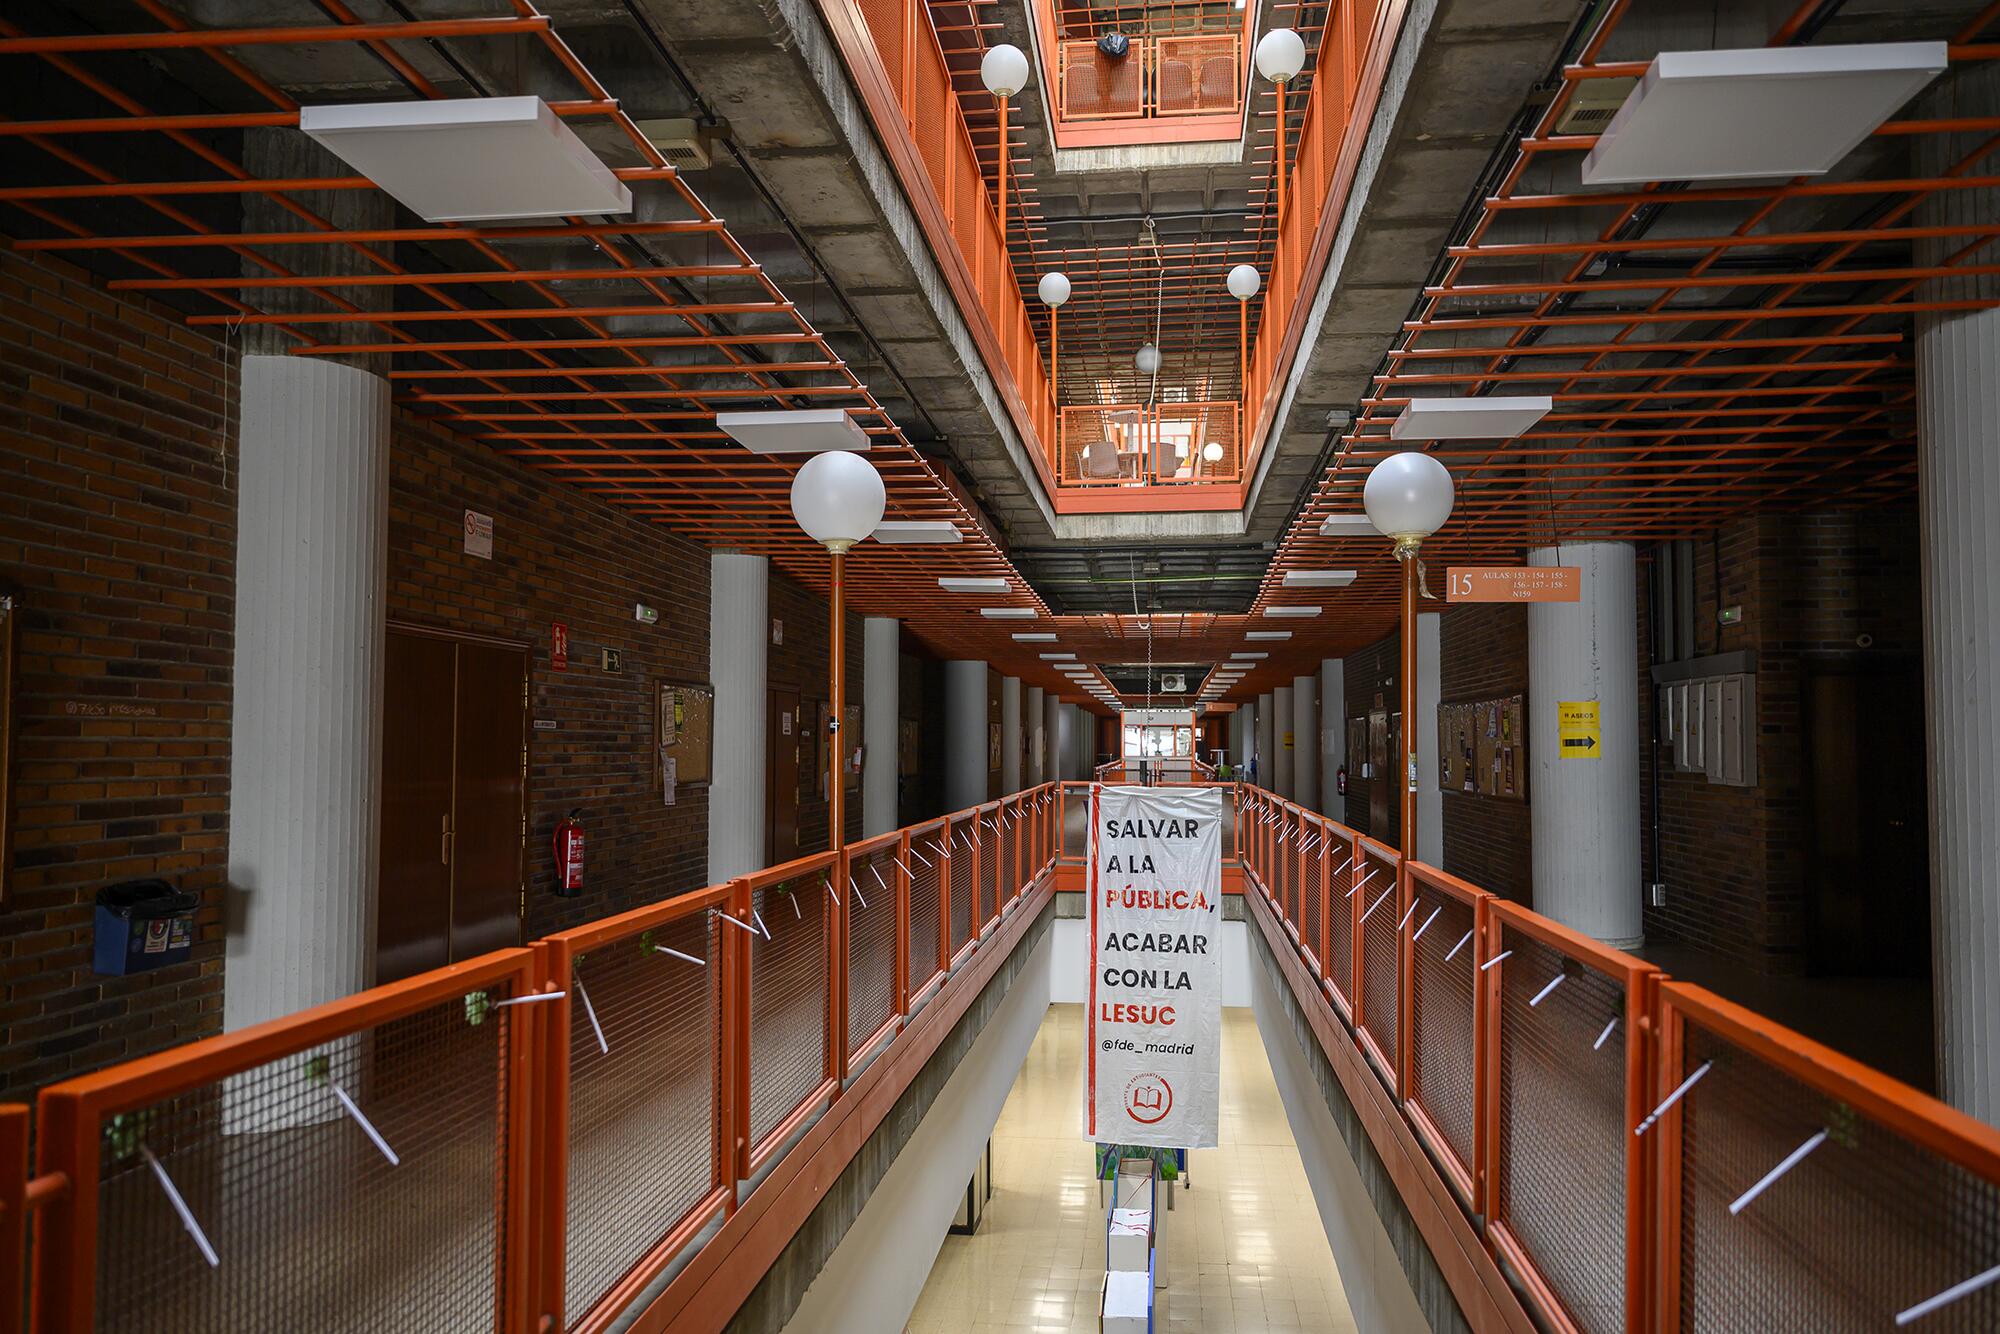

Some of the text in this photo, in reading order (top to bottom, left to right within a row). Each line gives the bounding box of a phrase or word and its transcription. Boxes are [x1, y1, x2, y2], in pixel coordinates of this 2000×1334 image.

[1451, 573, 1473, 596] 15
[1106, 819, 1199, 839] SALVAR
[1106, 855, 1156, 874] A LA
[1105, 884, 1216, 914] PÚBLICA,
[1104, 932, 1208, 955] ACABAR
[1103, 968, 1192, 991] CON LA
[1101, 1003, 1176, 1025] LESUC
[1101, 1038, 1195, 1055] @fde_madrid
